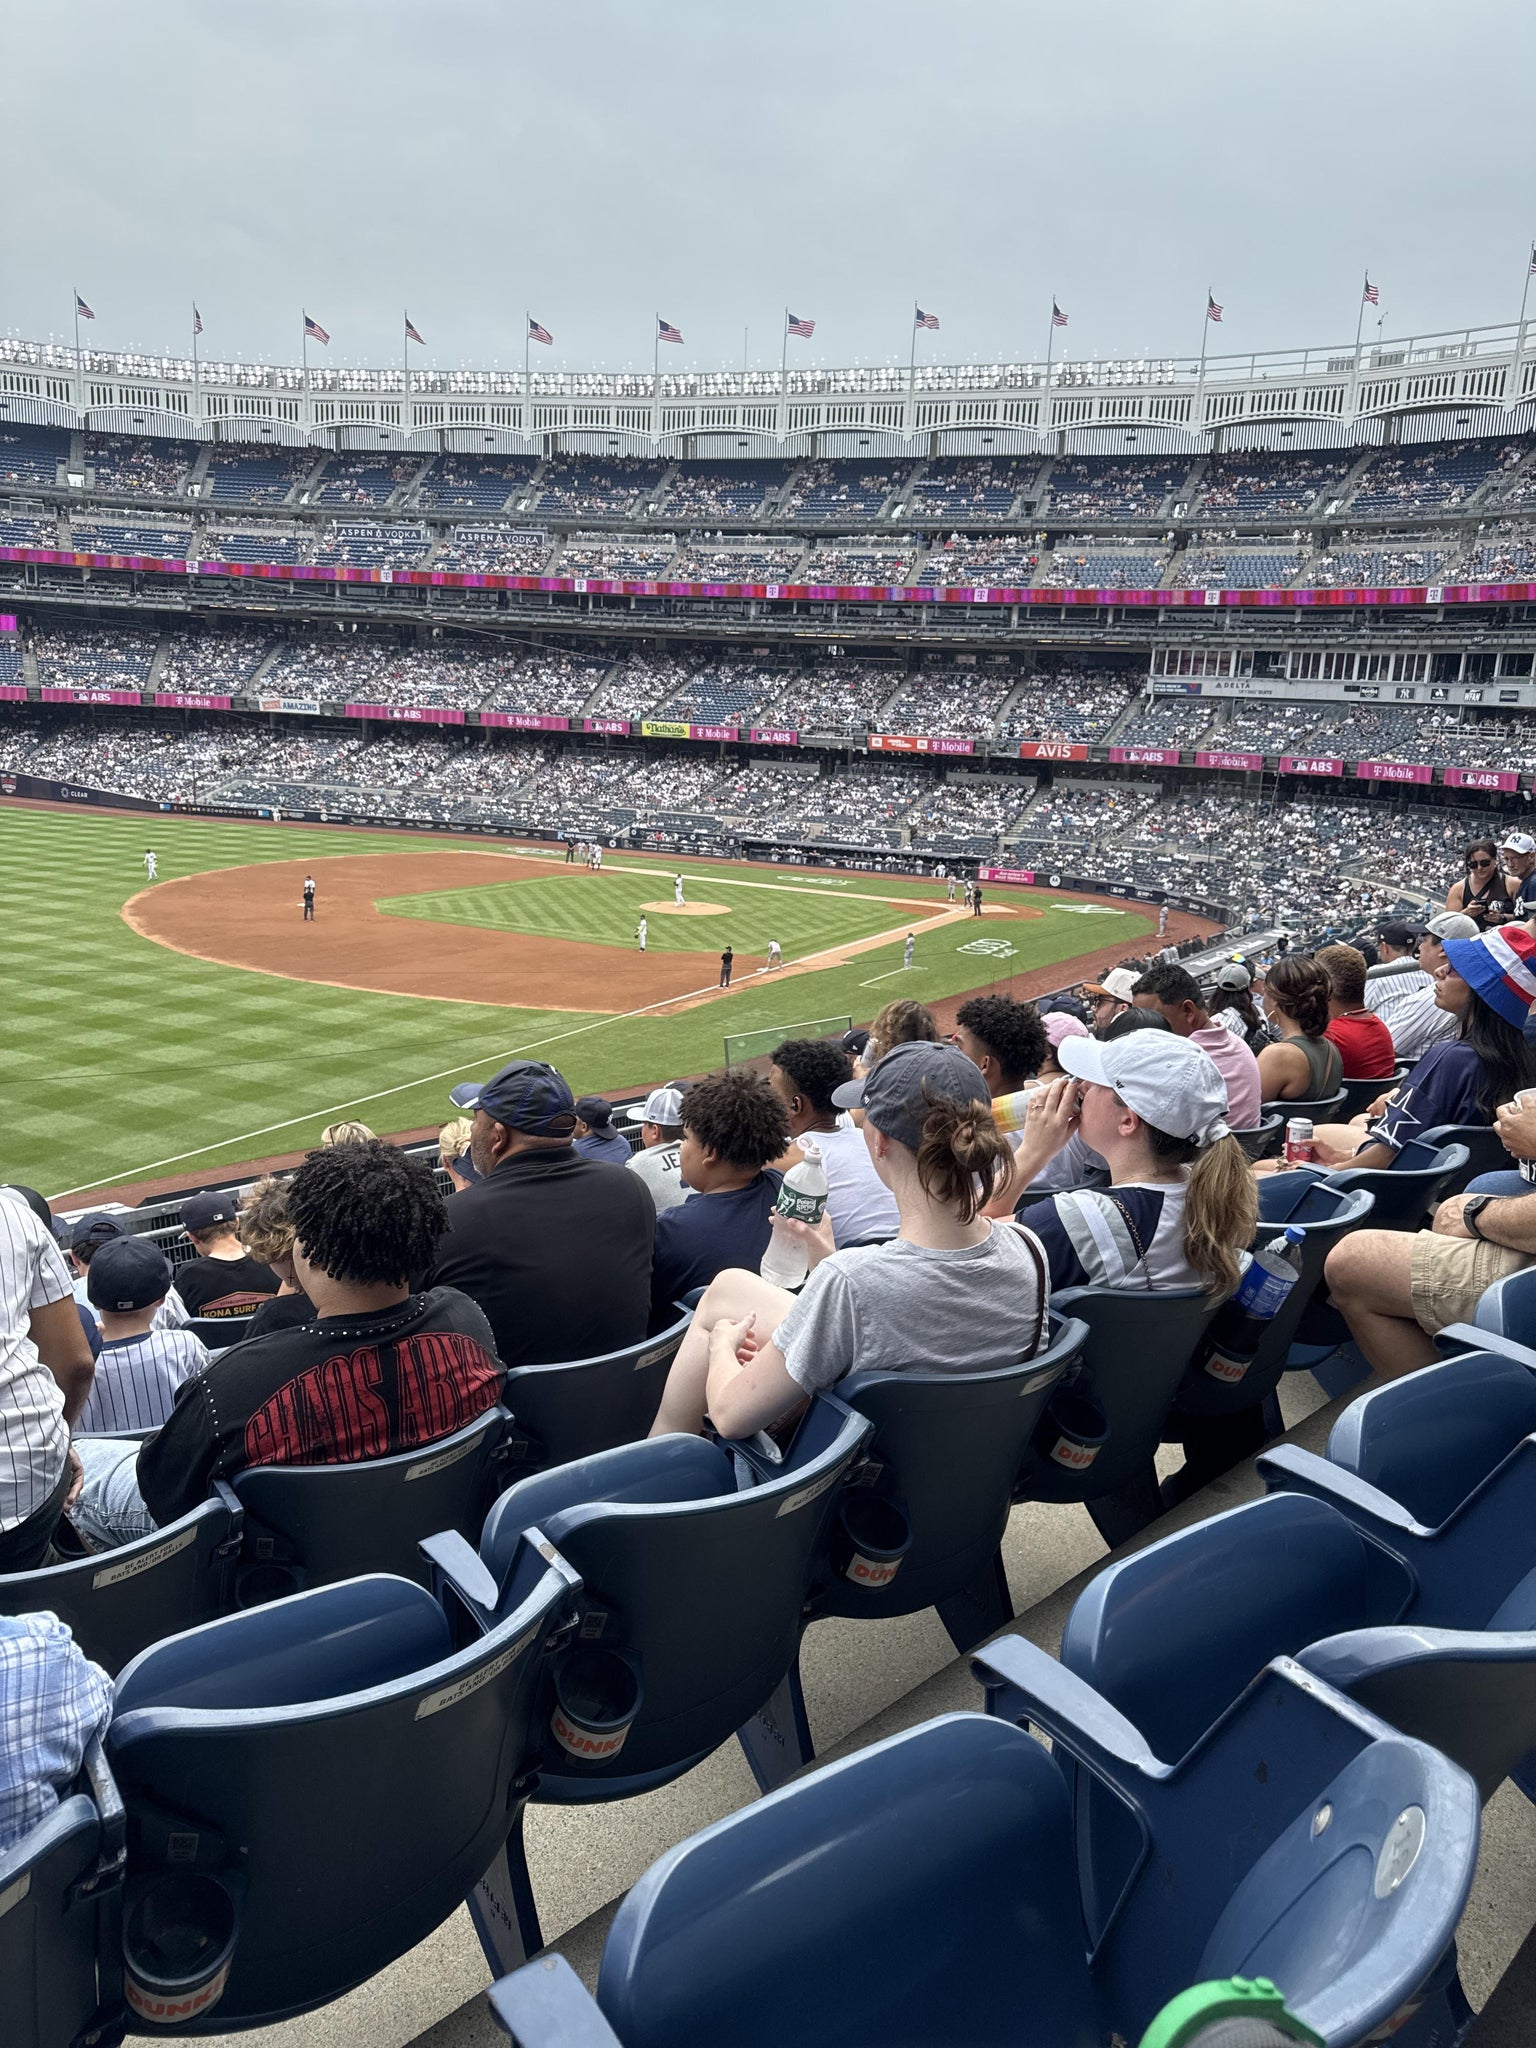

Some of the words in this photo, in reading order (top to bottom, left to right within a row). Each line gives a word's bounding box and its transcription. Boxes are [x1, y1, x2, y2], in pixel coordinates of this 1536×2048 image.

[340, 528, 372, 537] ASPEN
[384, 529, 417, 538] VODKA
[460, 533, 492, 542] ASPEN
[505, 535, 538, 544] VODKA
[91, 692, 111, 702] ABS
[184, 697, 211, 707] Mobile
[282, 702, 318, 711] AMAZING
[403, 710, 422, 719] ABS
[516, 717, 542, 728] Mobile
[605, 722, 623, 732] ABS
[705, 729, 730, 739] Mobile
[772, 733, 791, 742] ABS
[941, 741, 970, 752] Mobile
[1141, 752, 1164, 762] ABS
[1218, 755, 1248, 768] Mobile
[1310, 761, 1333, 772] ABS
[1383, 767, 1414, 779] Mobile
[1478, 774, 1499, 787] ABS
[662, 1151, 680, 1172] JE
[203, 1308, 232, 1318] KONA
[233, 1304, 256, 1315] SURF
[244, 1345, 390, 1468] CHAOS
[136, 1551, 158, 1565] ALERT
[160, 1543, 173, 1554] FOR
[111, 1569, 130, 1581] BATS
[162, 1542, 184, 1557] BALLS
[439, 1691, 463, 1706] BATS
